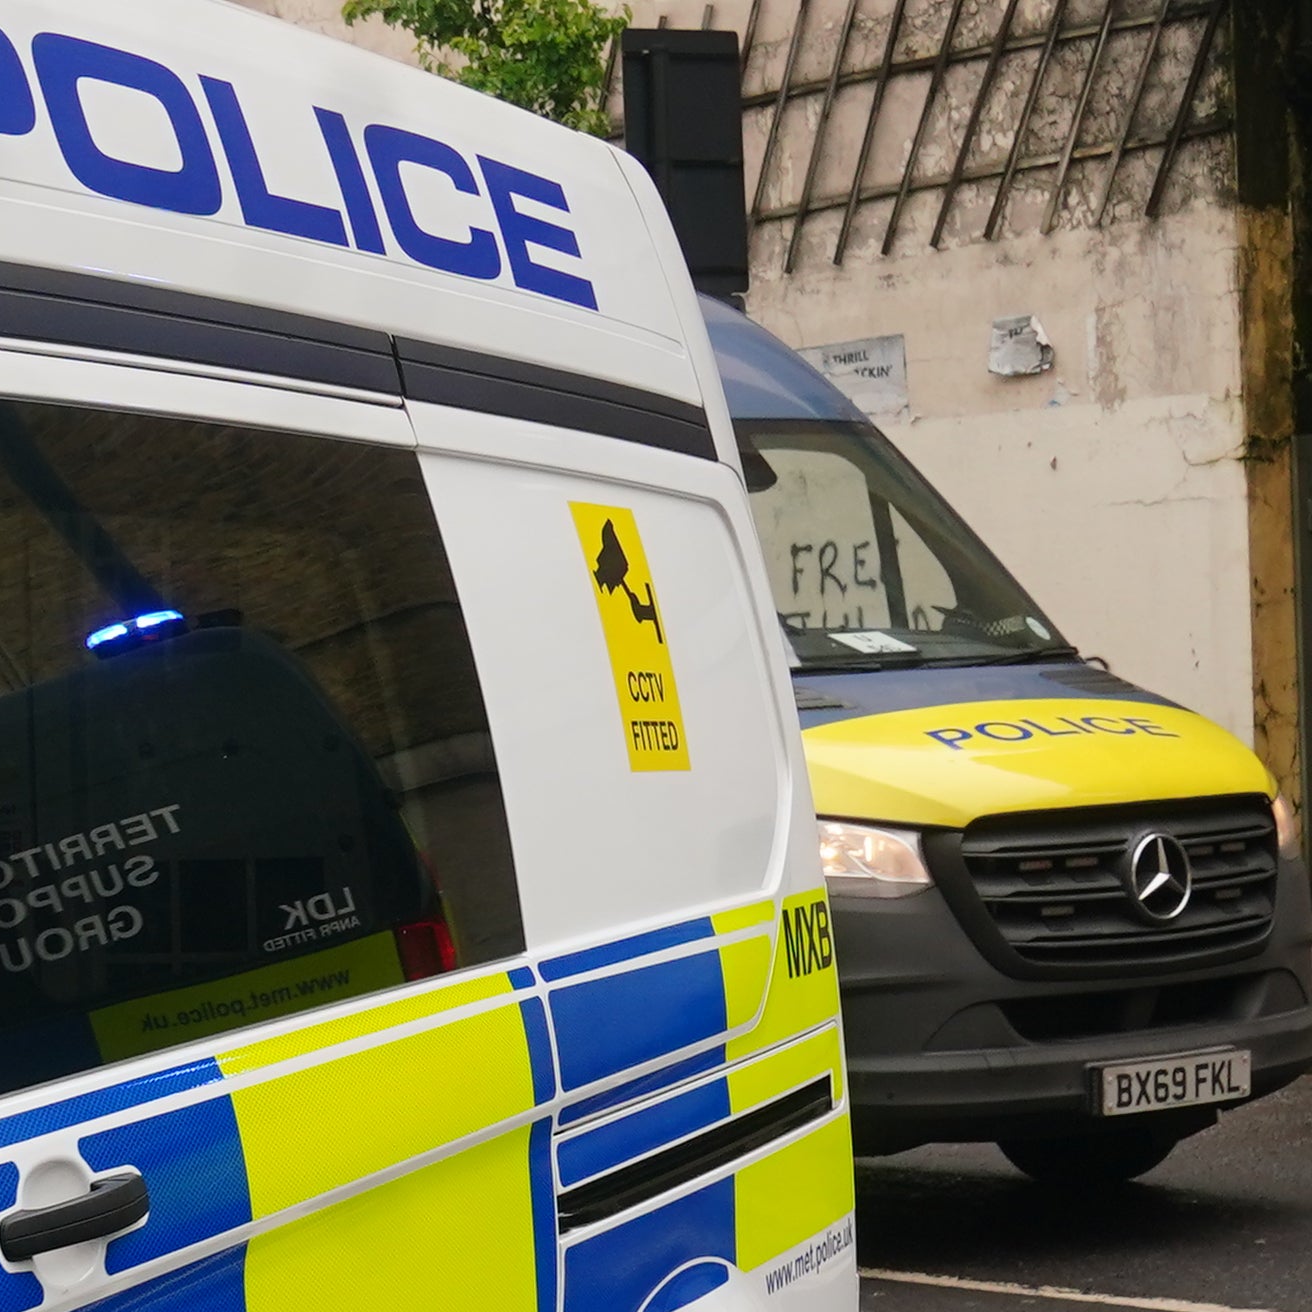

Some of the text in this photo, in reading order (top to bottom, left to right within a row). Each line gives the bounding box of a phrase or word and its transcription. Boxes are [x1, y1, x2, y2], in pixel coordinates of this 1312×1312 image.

[832, 350, 870, 365] THRILL
[627, 671, 664, 702] CCTV
[631, 721, 679, 751] FITTED
[924, 717, 1180, 750] POLICE
[783, 901, 832, 979] MXB
[1116, 1059, 1239, 1108] BX69 FKL
[765, 1217, 853, 1295] www.met.police.uk
